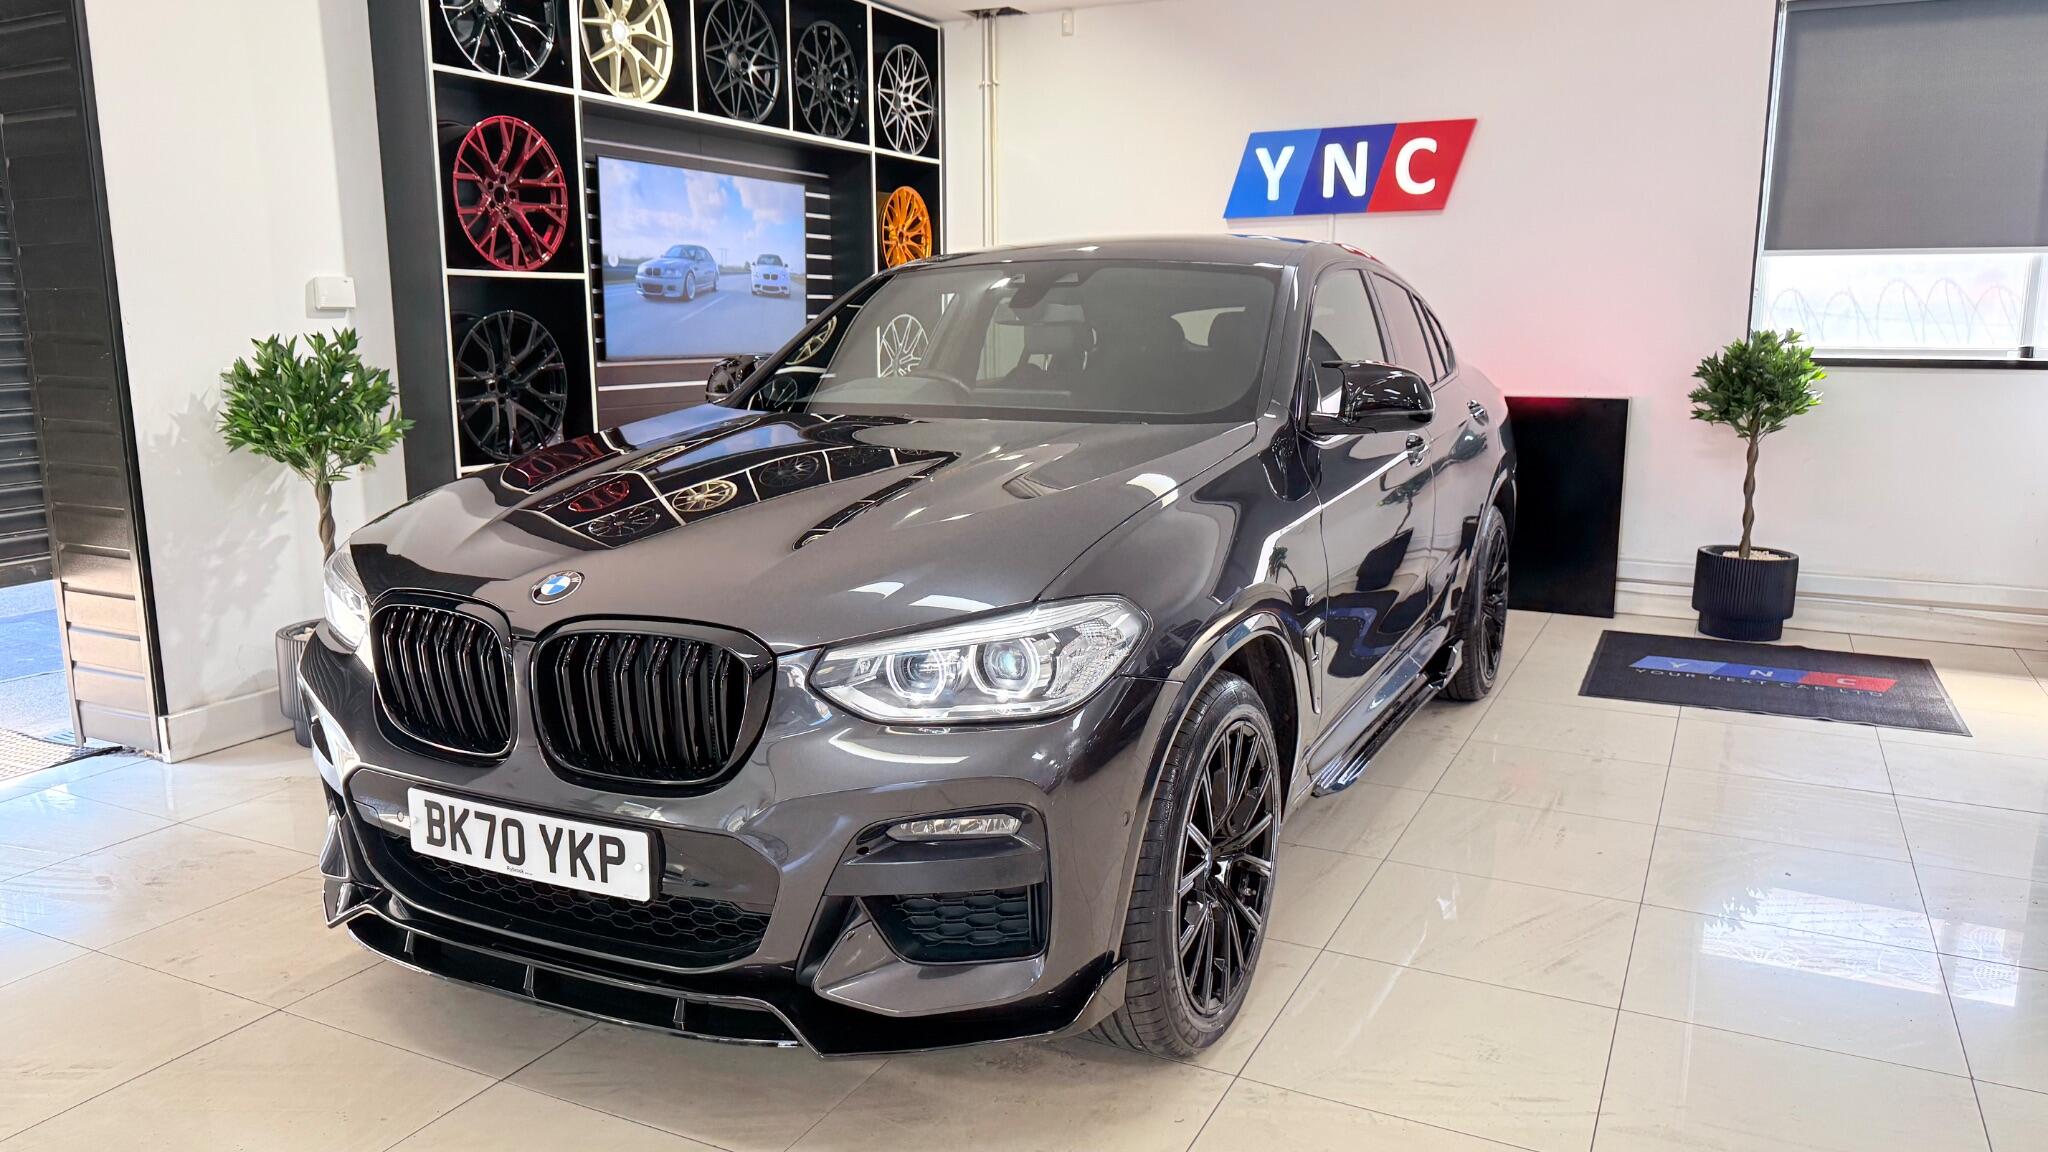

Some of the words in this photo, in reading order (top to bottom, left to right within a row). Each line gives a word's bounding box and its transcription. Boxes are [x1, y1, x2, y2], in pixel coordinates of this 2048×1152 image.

[1255, 137, 1438, 201] YNC
[1636, 668, 1696, 678] YOUR
[1708, 675, 1767, 685] NEXT
[1780, 682, 1825, 691] CAR
[1839, 688, 1882, 697] LTD
[424, 799, 526, 866] BK70
[538, 824, 626, 883] YKP
